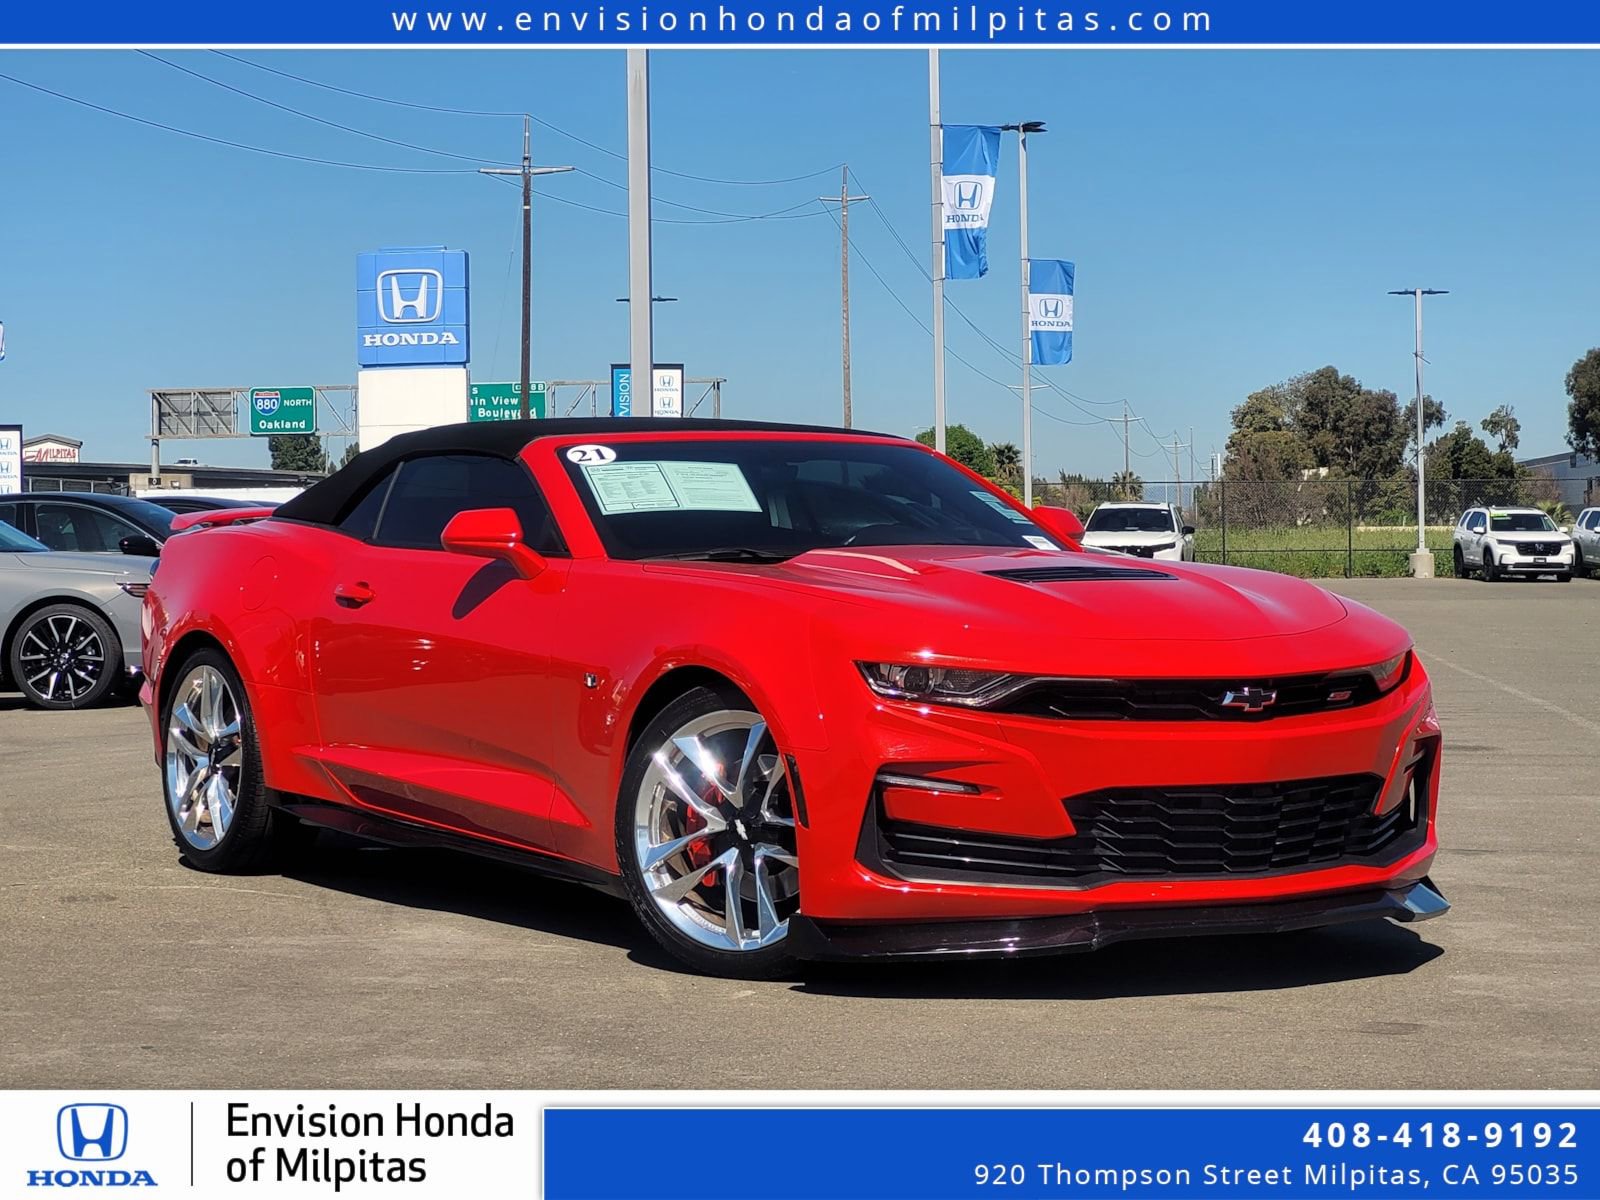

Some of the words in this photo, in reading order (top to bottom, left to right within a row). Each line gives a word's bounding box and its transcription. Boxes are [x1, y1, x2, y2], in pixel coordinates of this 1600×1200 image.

[1031, 320, 1072, 328] HONDA
[363, 331, 459, 347] HONDA
[491, 396, 519, 406] View
[618, 373, 630, 417] VISION
[256, 398, 278, 410] 880
[283, 398, 313, 407] NORTH
[478, 407, 537, 419] Boulevd
[259, 419, 306, 430] Oakland
[34, 447, 77, 463] MILPITAS
[571, 447, 608, 463] 21
